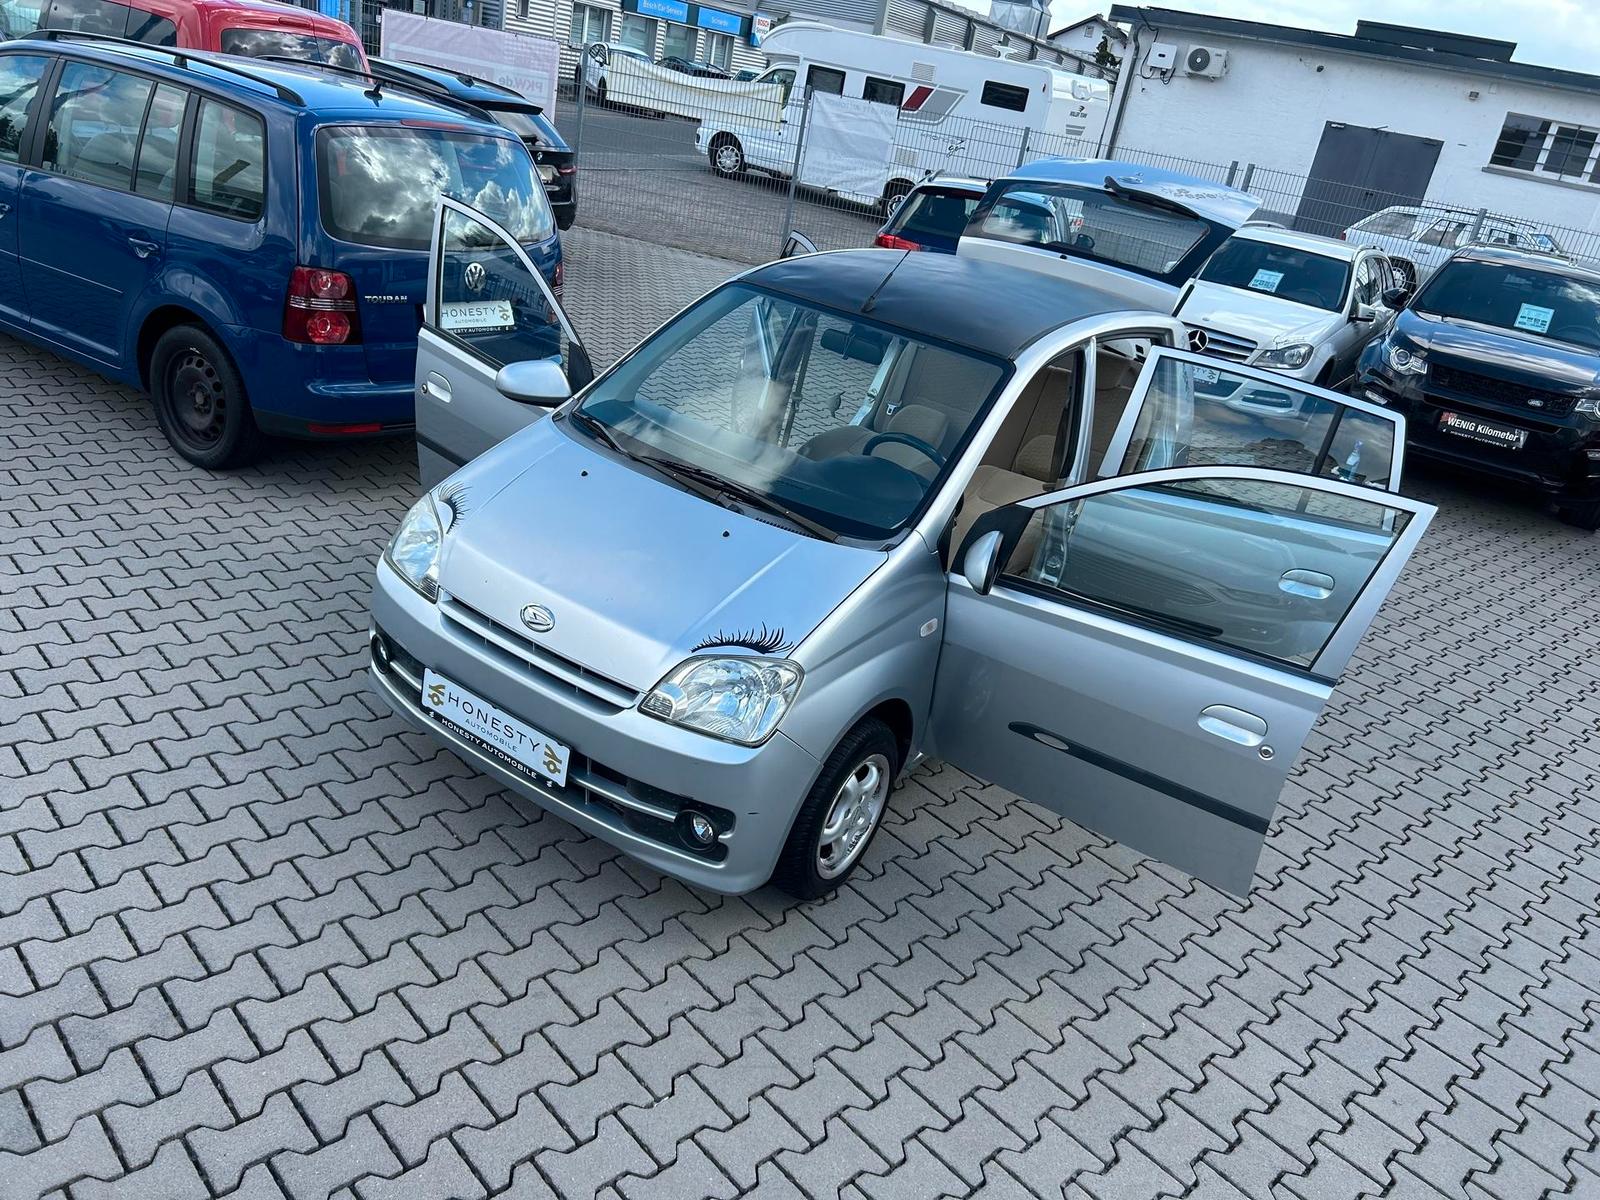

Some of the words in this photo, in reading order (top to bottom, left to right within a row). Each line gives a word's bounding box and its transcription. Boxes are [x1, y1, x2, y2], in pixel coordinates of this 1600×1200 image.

[365, 295, 408, 304] TOURAN
[442, 306, 497, 317] HONESTY
[1447, 417, 1475, 431] WENIG
[1476, 423, 1519, 442] Kilometer
[448, 691, 540, 752] HONESTY
[465, 718, 518, 752] AUTOMOBILE
[441, 718, 481, 745] HONESTY
[481, 742, 537, 779] AUTOMOBILE
